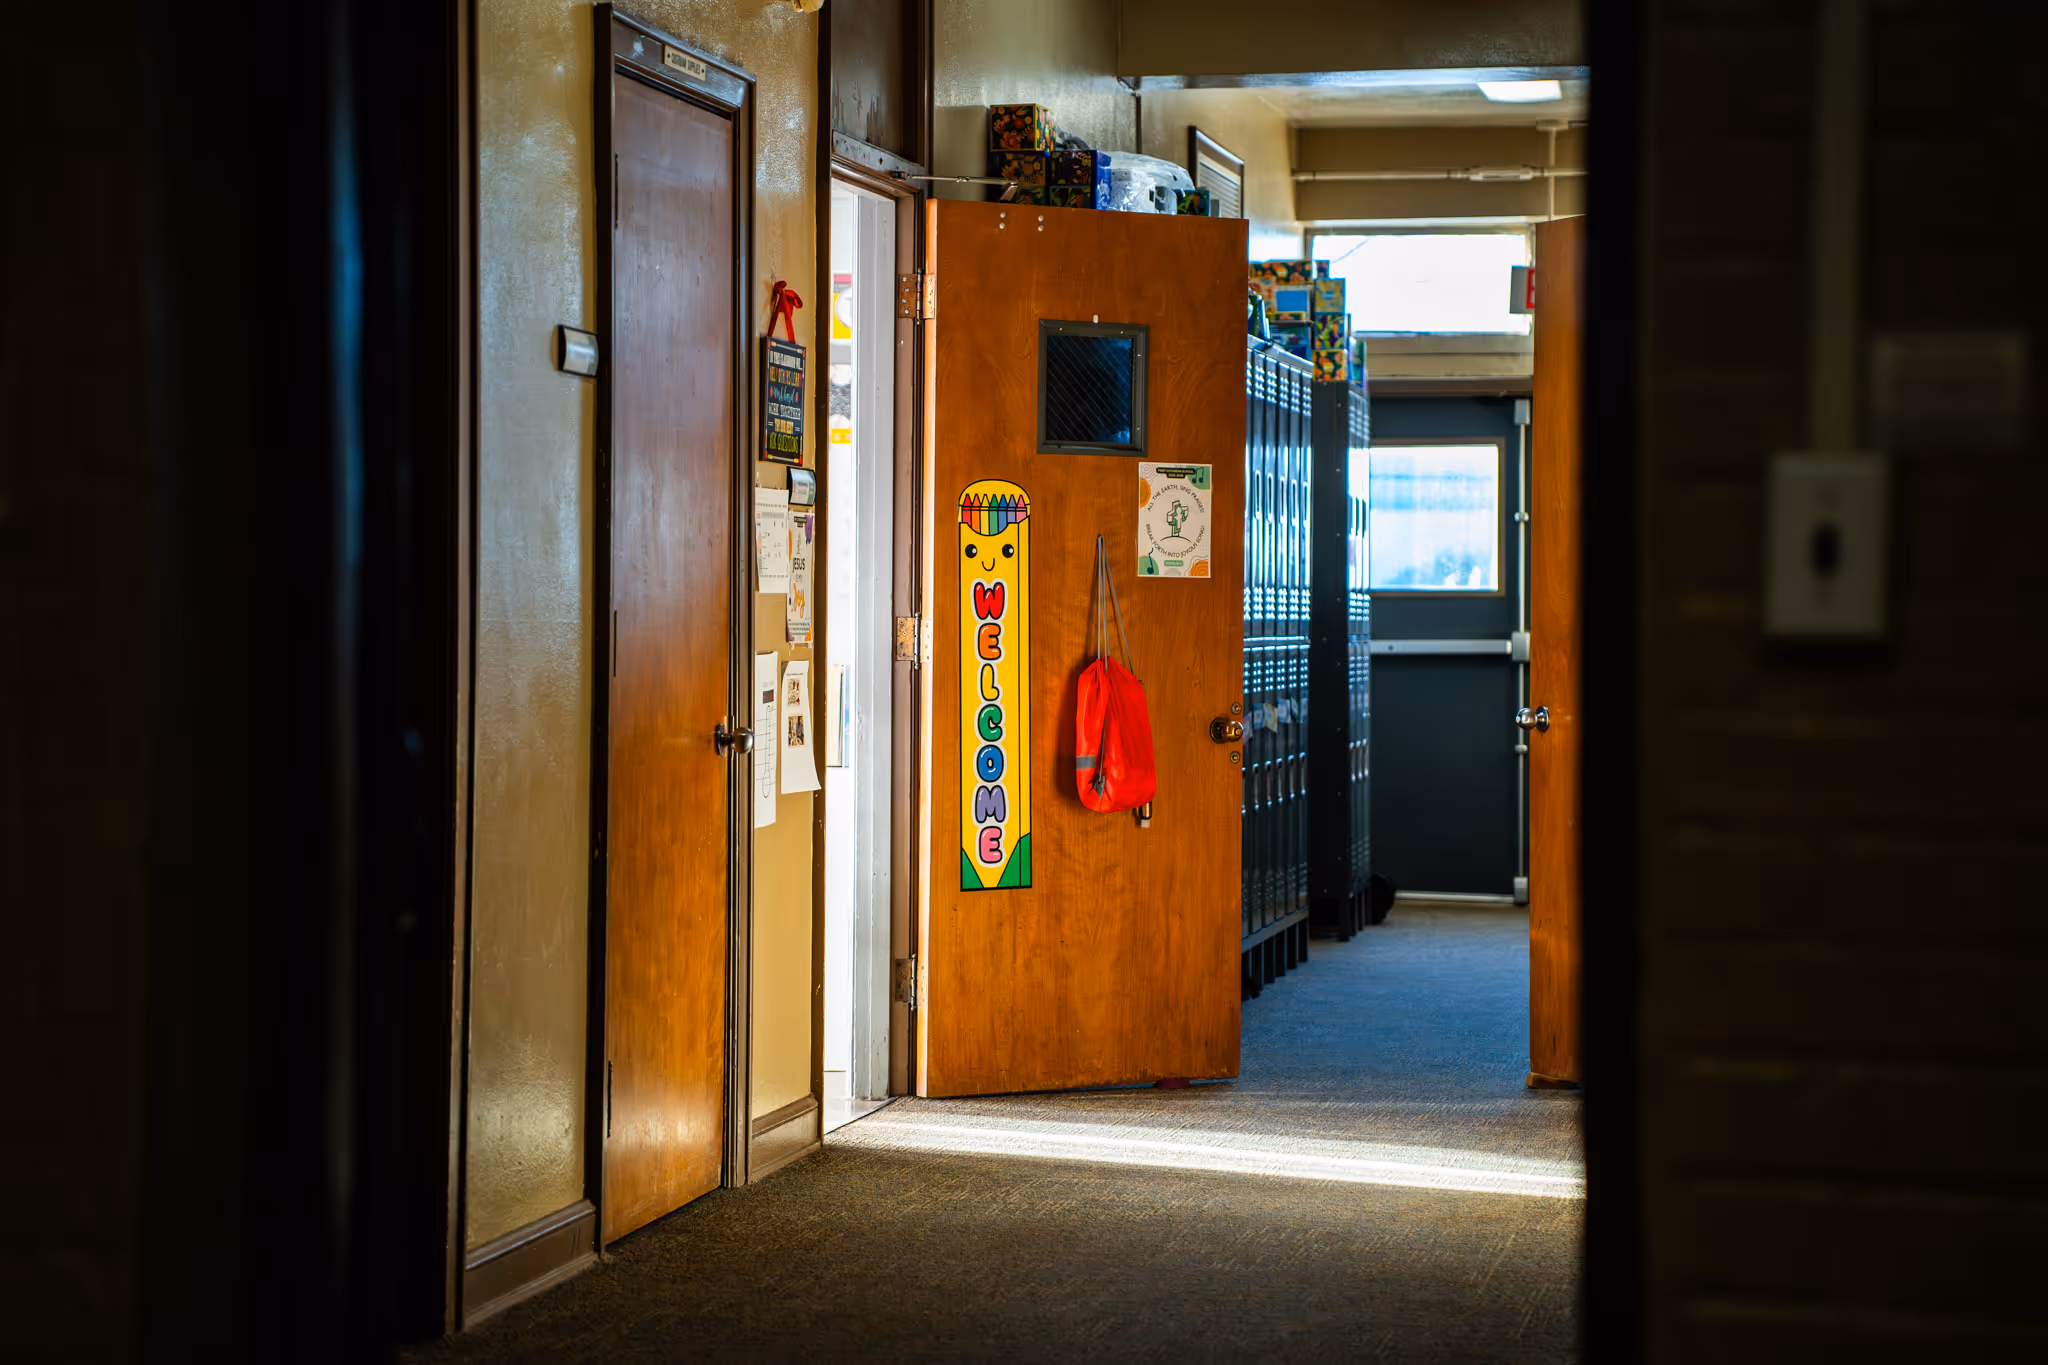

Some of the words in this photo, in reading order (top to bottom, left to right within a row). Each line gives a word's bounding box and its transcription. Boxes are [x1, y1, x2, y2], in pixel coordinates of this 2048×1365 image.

[778, 433, 799, 453] QUESTIONS
[1152, 491, 1161, 501] THE
[1179, 485, 1191, 494] SING
[1146, 523, 1154, 543] BREAK
[1153, 541, 1167, 556] FORTH
[1180, 542, 1198, 558] JOYOUS
[792, 557, 806, 573] JESUS
[793, 583, 806, 619] Joy
[974, 581, 1006, 864] WELCOME
